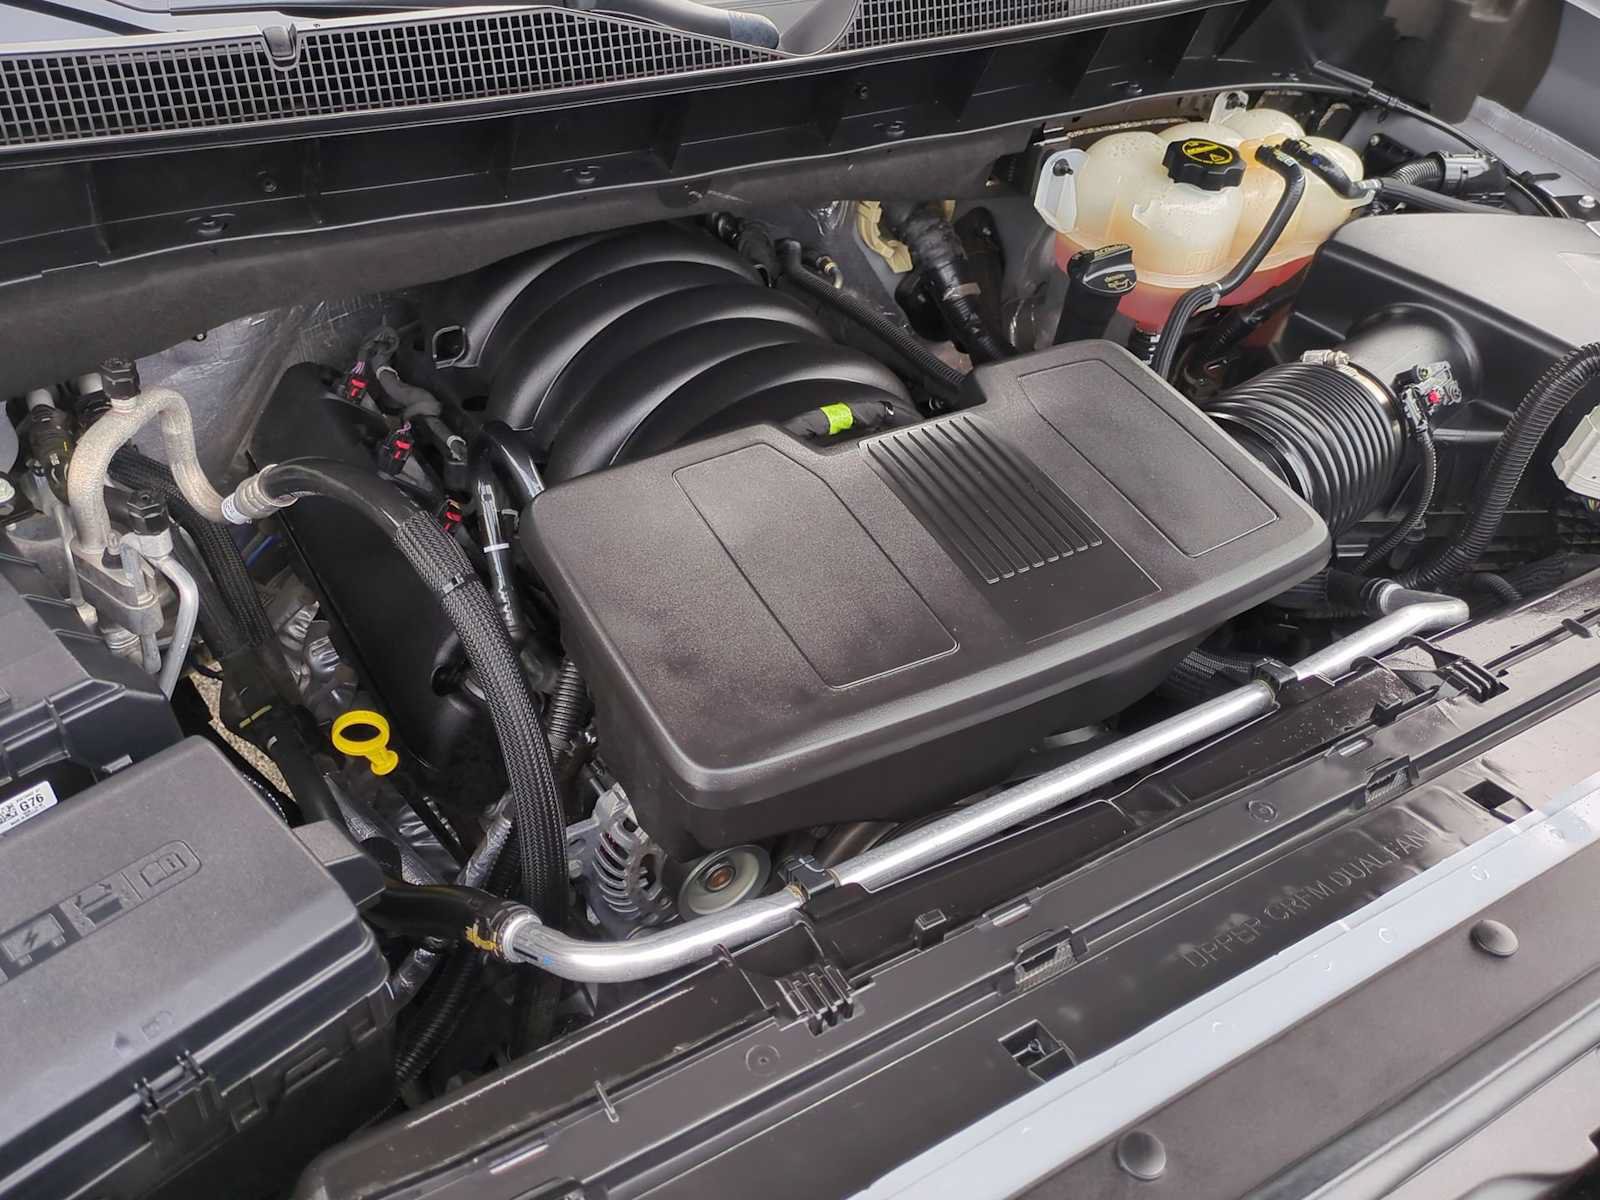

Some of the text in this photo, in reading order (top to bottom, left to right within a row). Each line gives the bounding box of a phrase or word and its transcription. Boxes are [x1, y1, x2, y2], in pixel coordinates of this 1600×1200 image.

[19, 793, 45, 812] G76
[1182, 917, 1263, 969] UPPER
[1328, 852, 1393, 888] DUAL
